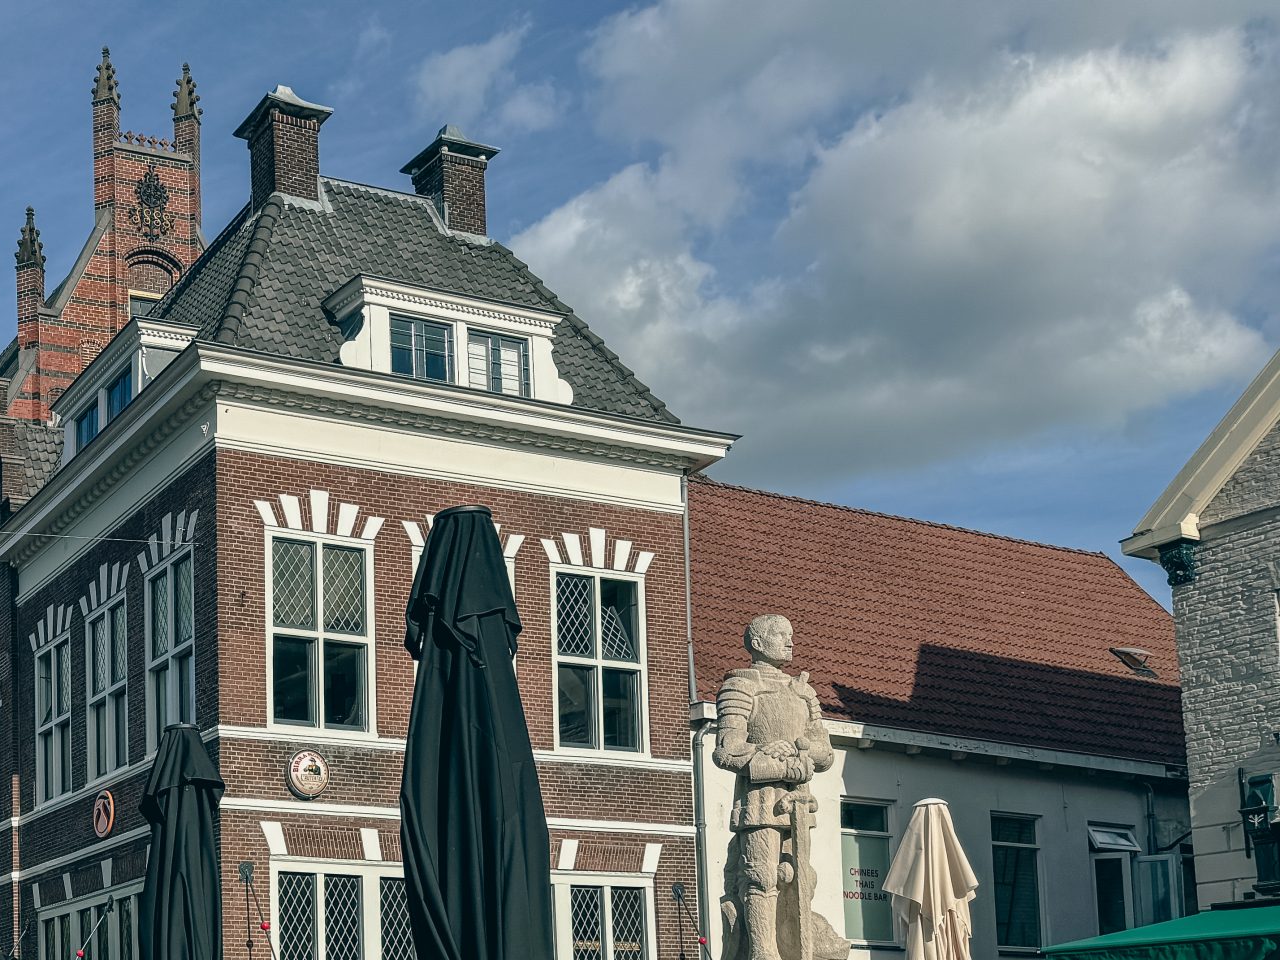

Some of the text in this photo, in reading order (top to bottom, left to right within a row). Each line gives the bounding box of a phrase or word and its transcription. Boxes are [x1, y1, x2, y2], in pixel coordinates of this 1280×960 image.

[293, 753, 307, 772] BIRRA
[850, 868, 879, 877] CHINEES
[855, 880, 874, 888] THAIS
[843, 891, 887, 901] NOODLE BAR
